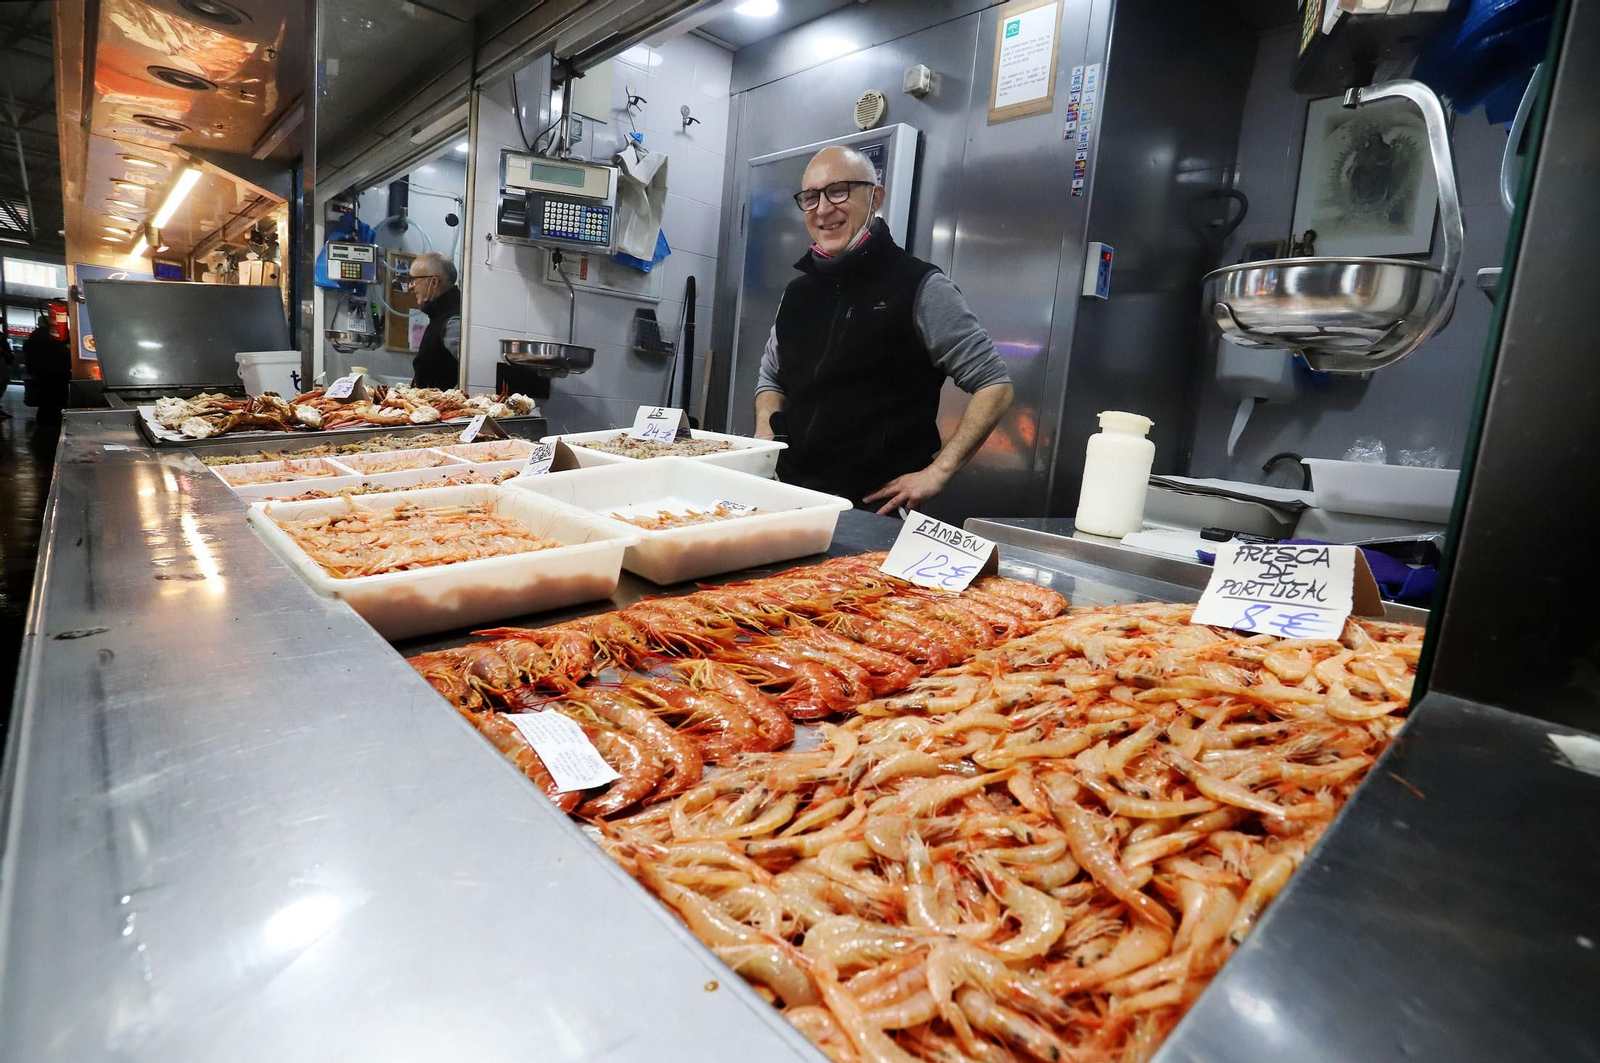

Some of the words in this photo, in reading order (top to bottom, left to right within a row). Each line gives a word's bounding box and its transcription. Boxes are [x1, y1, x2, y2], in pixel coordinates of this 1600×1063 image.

[916, 519, 986, 552] GAMBÓN
[1233, 545, 1330, 568] FRESCA
[1258, 564, 1298, 584] DE
[1216, 578, 1328, 602] PORTUGAL
